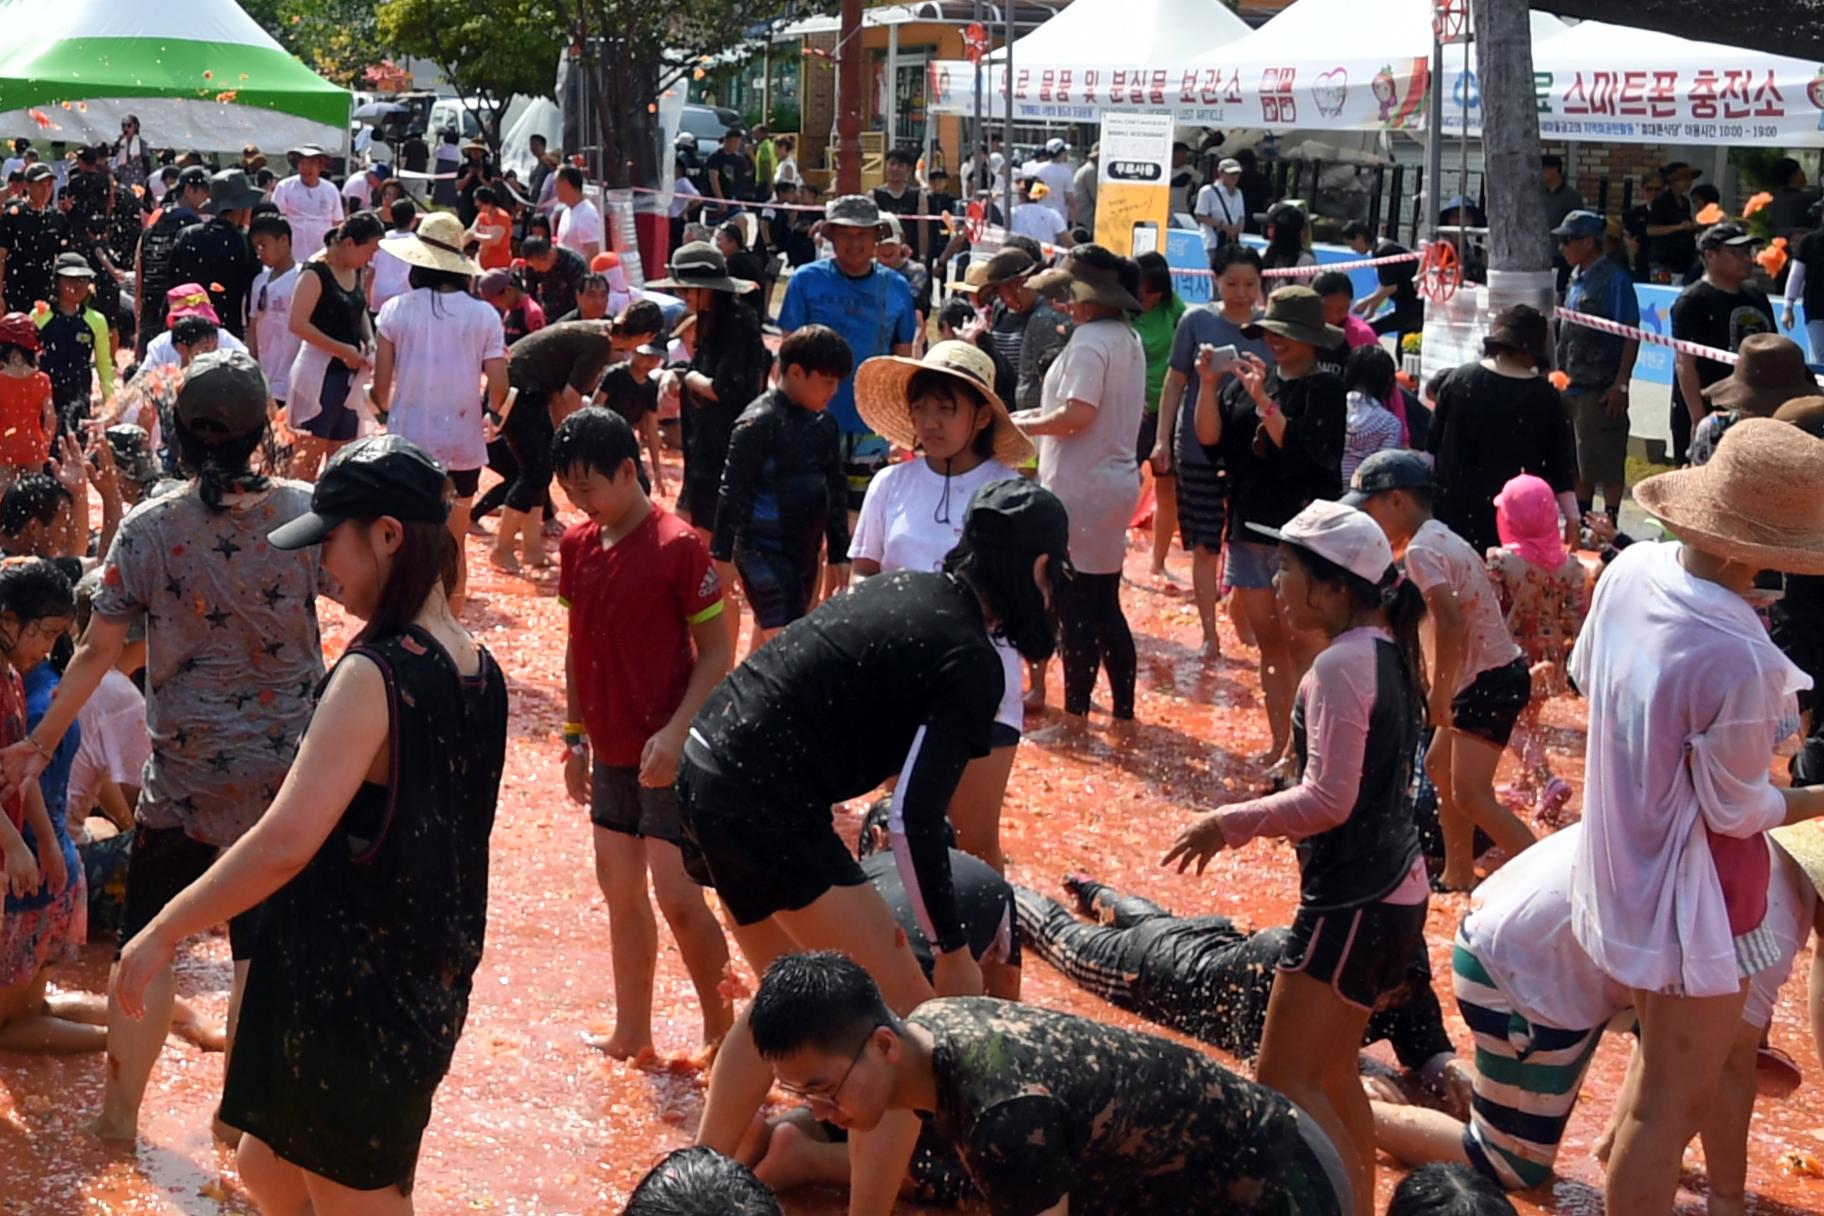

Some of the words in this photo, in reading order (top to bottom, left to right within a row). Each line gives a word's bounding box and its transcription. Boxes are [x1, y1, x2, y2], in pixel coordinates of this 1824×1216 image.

[1039, 69, 1072, 103] 물품
[1083, 69, 1100, 104] 및
[1109, 69, 1168, 105] 분실물
[1179, 68, 1243, 105] 보관소
[1562, 71, 1678, 119] 스마트폰
[1688, 70, 1785, 119] 충전소
[1718, 124, 1743, 138] 10:00
[1753, 125, 1778, 139] 19:00
